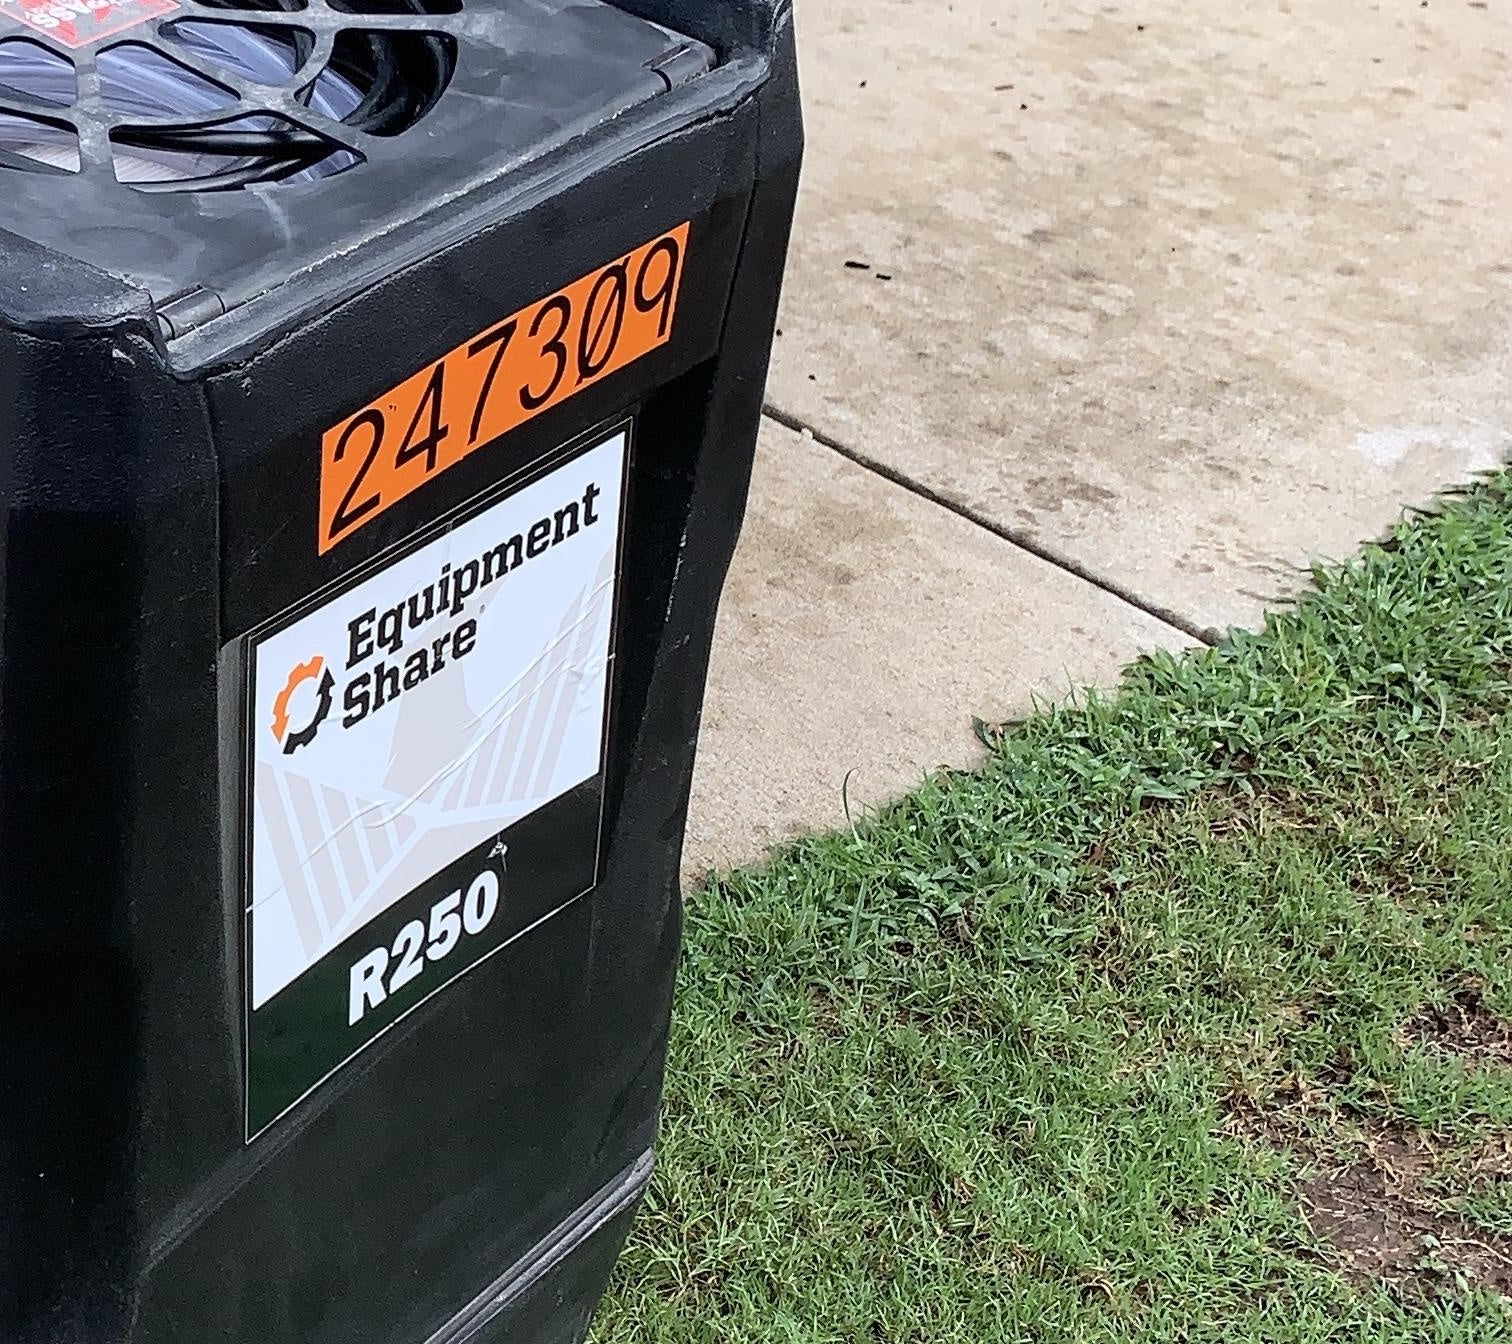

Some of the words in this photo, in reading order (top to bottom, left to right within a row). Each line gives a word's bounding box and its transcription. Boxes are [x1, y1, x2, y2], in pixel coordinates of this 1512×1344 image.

[328, 236, 680, 540] 247309
[346, 482, 601, 671] Equipment
[342, 618, 478, 730] Share
[348, 869, 500, 1026] R250
